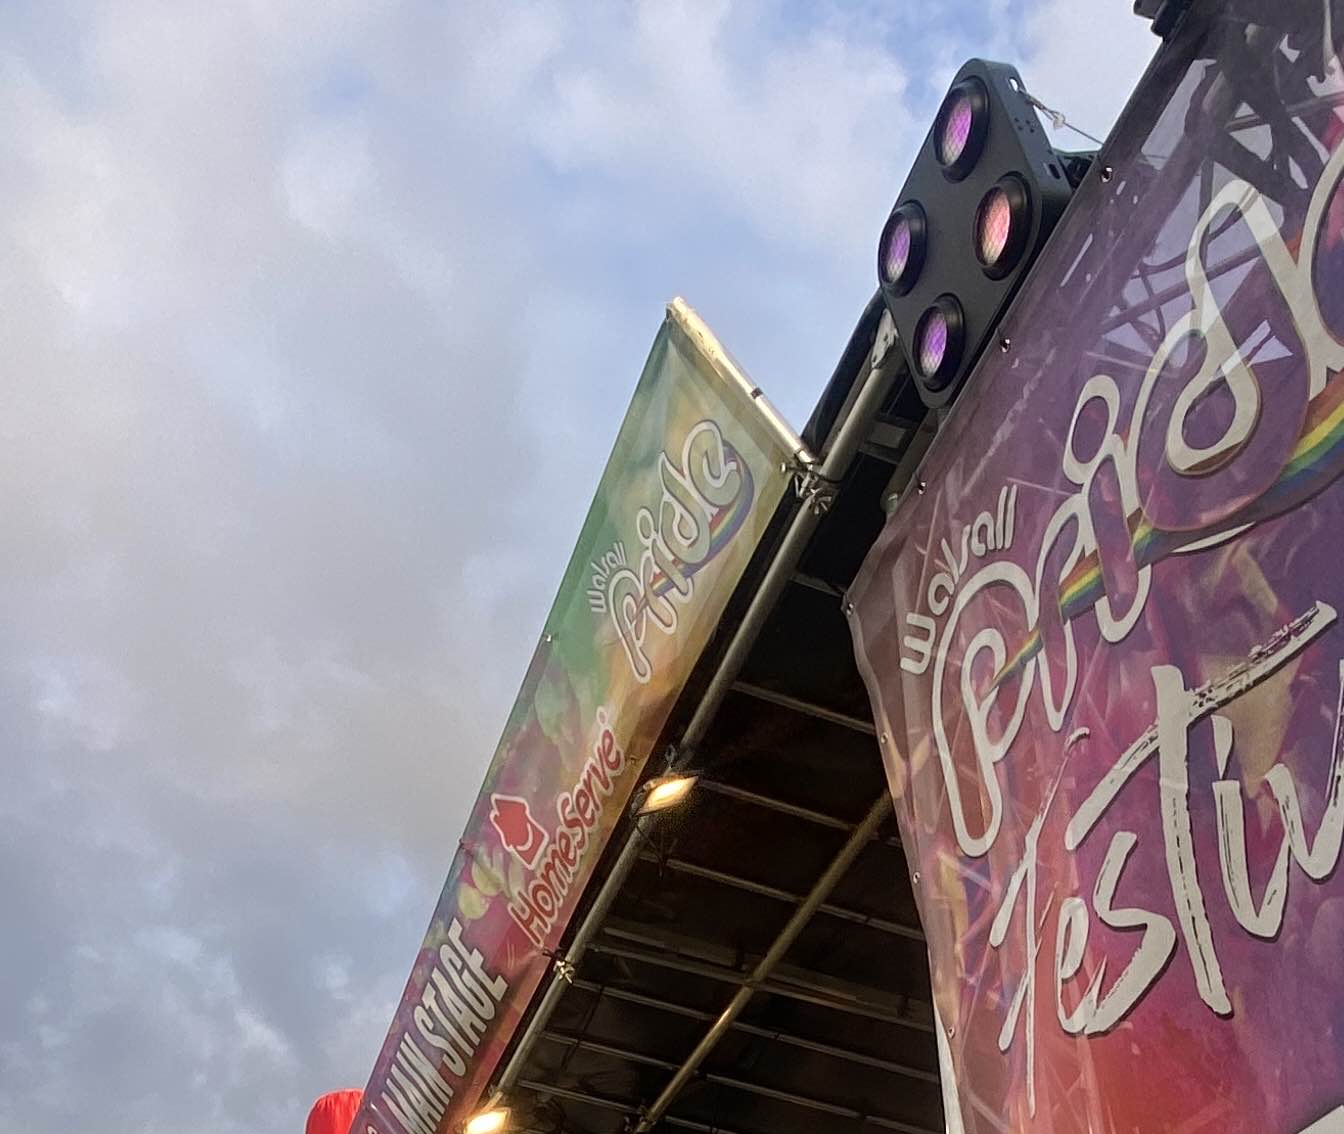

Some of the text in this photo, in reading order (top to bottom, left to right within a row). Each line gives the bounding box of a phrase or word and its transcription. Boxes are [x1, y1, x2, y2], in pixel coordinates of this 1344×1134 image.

[587, 541, 626, 614] Walsall
[609, 419, 740, 684] Pride
[900, 484, 1017, 675] Walsall
[508, 725, 624, 946] HomeServe
[414, 917, 508, 1077] STAGE
